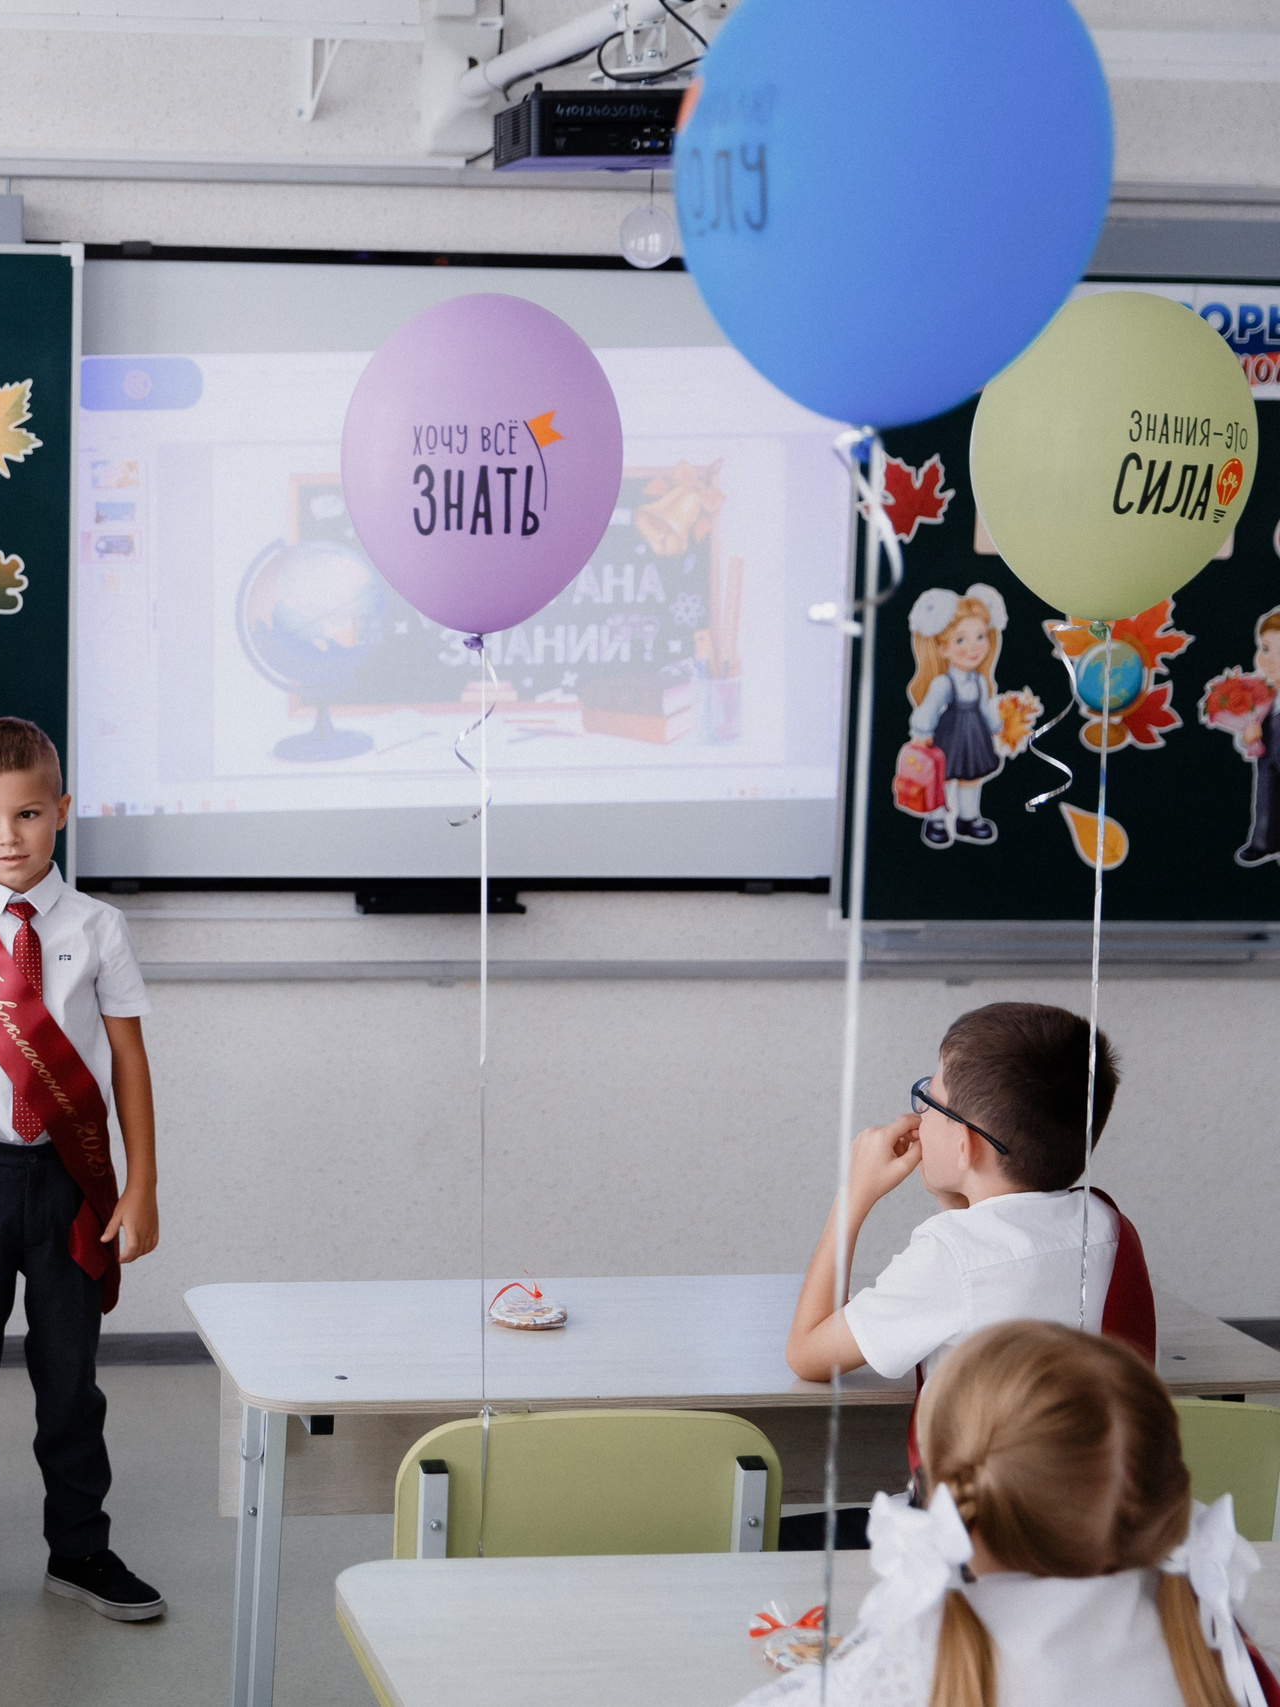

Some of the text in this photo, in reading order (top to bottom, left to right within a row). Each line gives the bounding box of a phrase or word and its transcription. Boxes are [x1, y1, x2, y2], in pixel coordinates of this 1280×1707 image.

[413, 419, 519, 456] ХОЧУ ВСЁ
[413, 463, 540, 537] ЗНАТЬ
[1112, 452, 1215, 521] СИЛА
[571, 562, 667, 605] АНА
